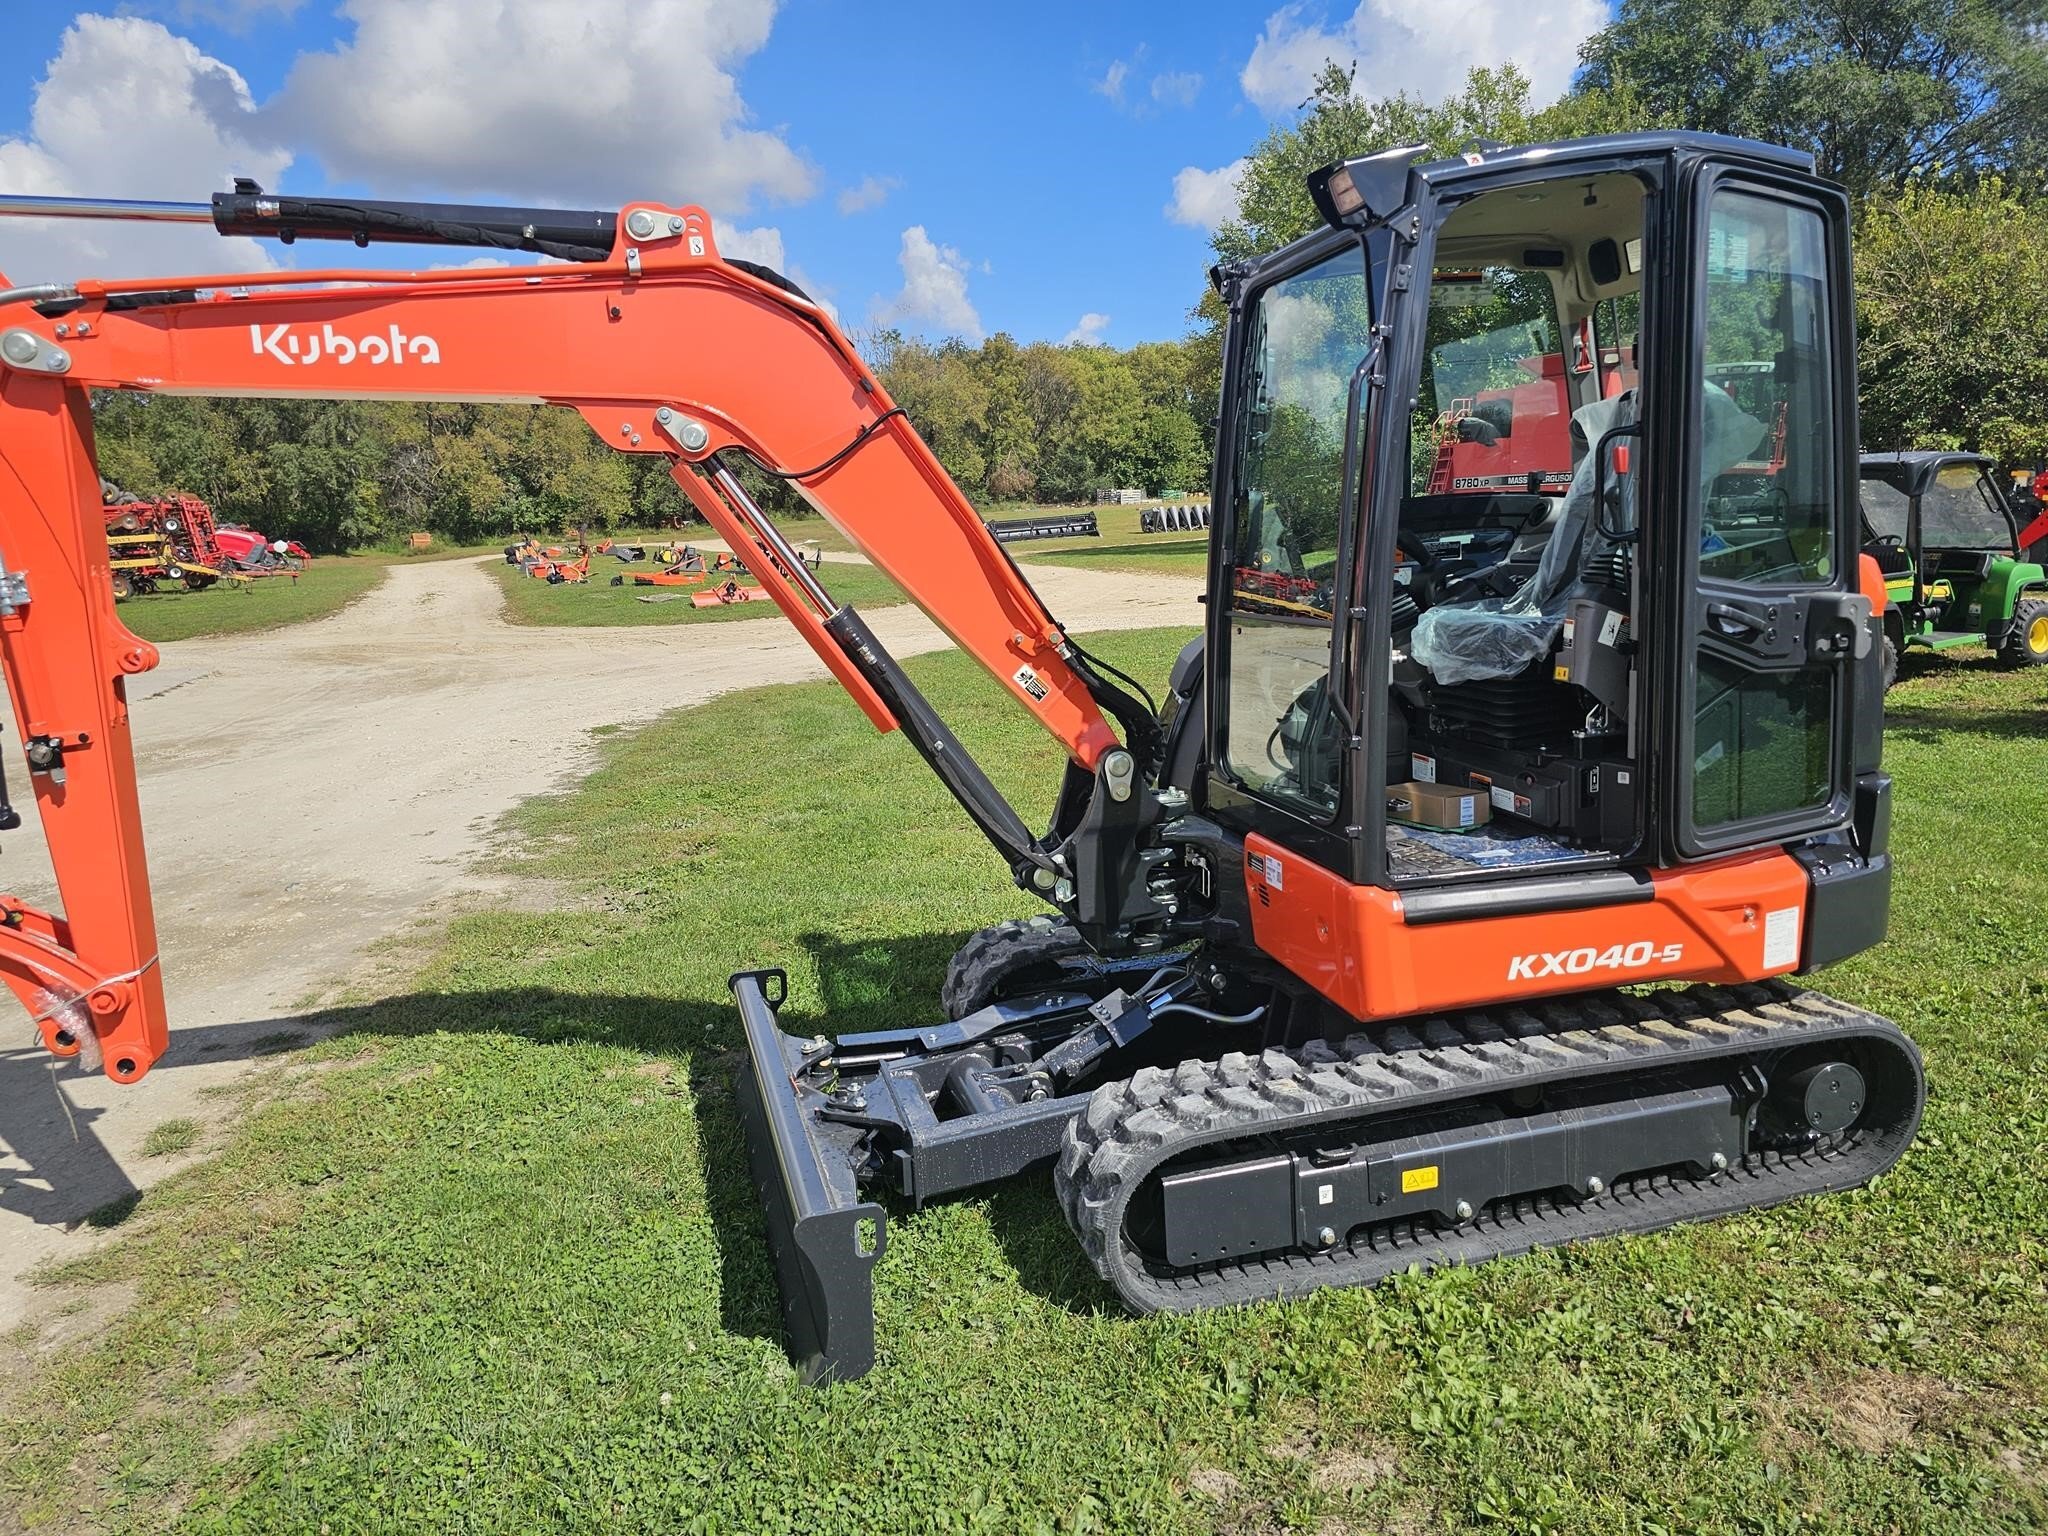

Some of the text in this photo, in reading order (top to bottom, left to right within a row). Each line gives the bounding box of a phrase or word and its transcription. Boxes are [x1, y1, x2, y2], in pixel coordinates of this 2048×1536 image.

[250, 324, 441, 365] Kubota
[1507, 476, 1529, 485] MASS
[1541, 473, 1573, 483] RGUSO
[1507, 941, 1684, 981] KX040-5
